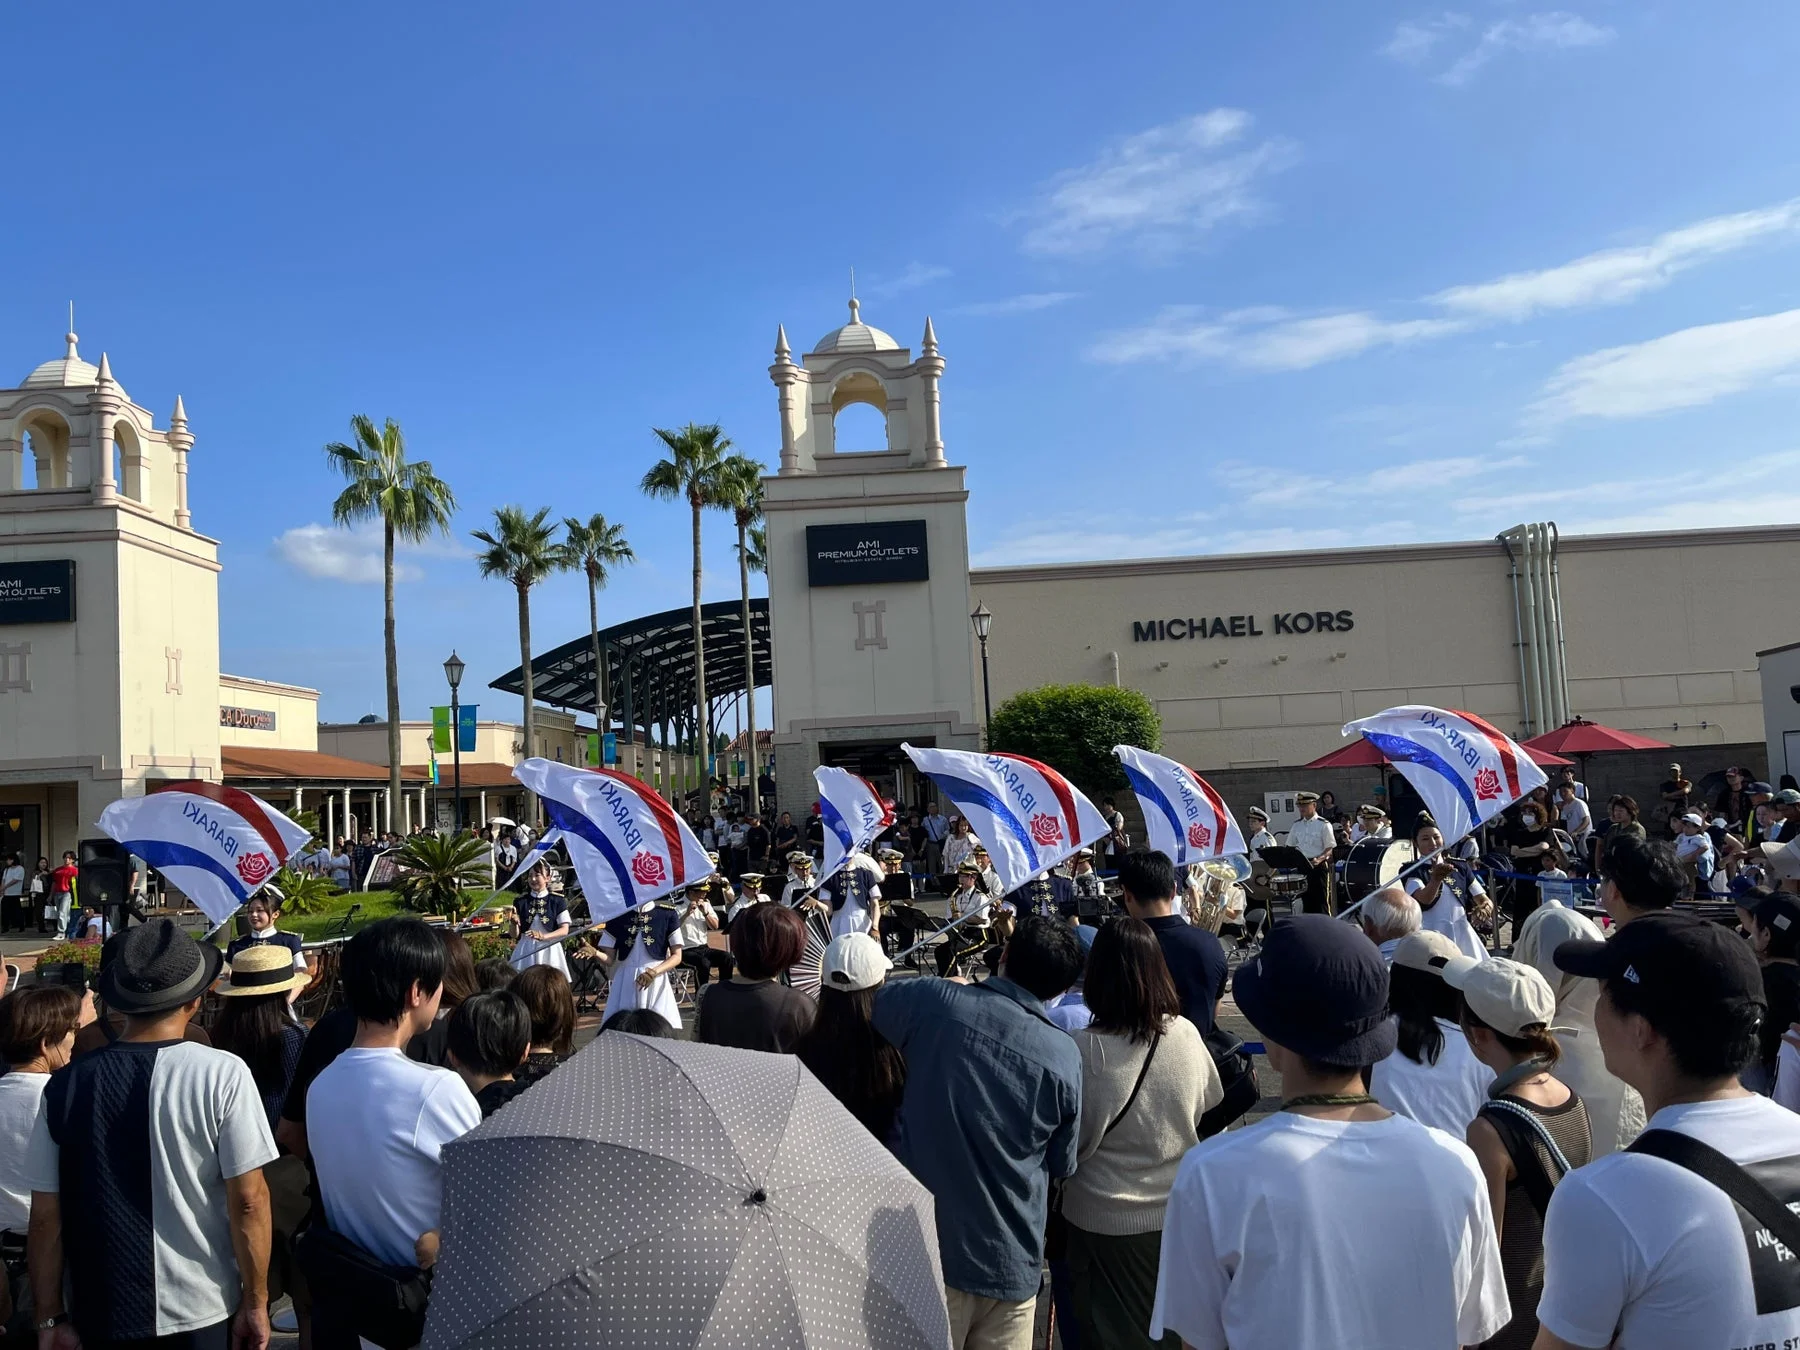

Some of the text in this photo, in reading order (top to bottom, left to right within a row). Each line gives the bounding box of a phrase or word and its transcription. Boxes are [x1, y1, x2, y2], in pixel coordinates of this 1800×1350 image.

[857, 540, 880, 550] AMI
[818, 546, 919, 559] PREMIUM OUTLETS
[0, 579, 22, 589] AMI
[11, 586, 61, 596] OUTLETS
[1133, 609, 1354, 642] MICHAEL KORS
